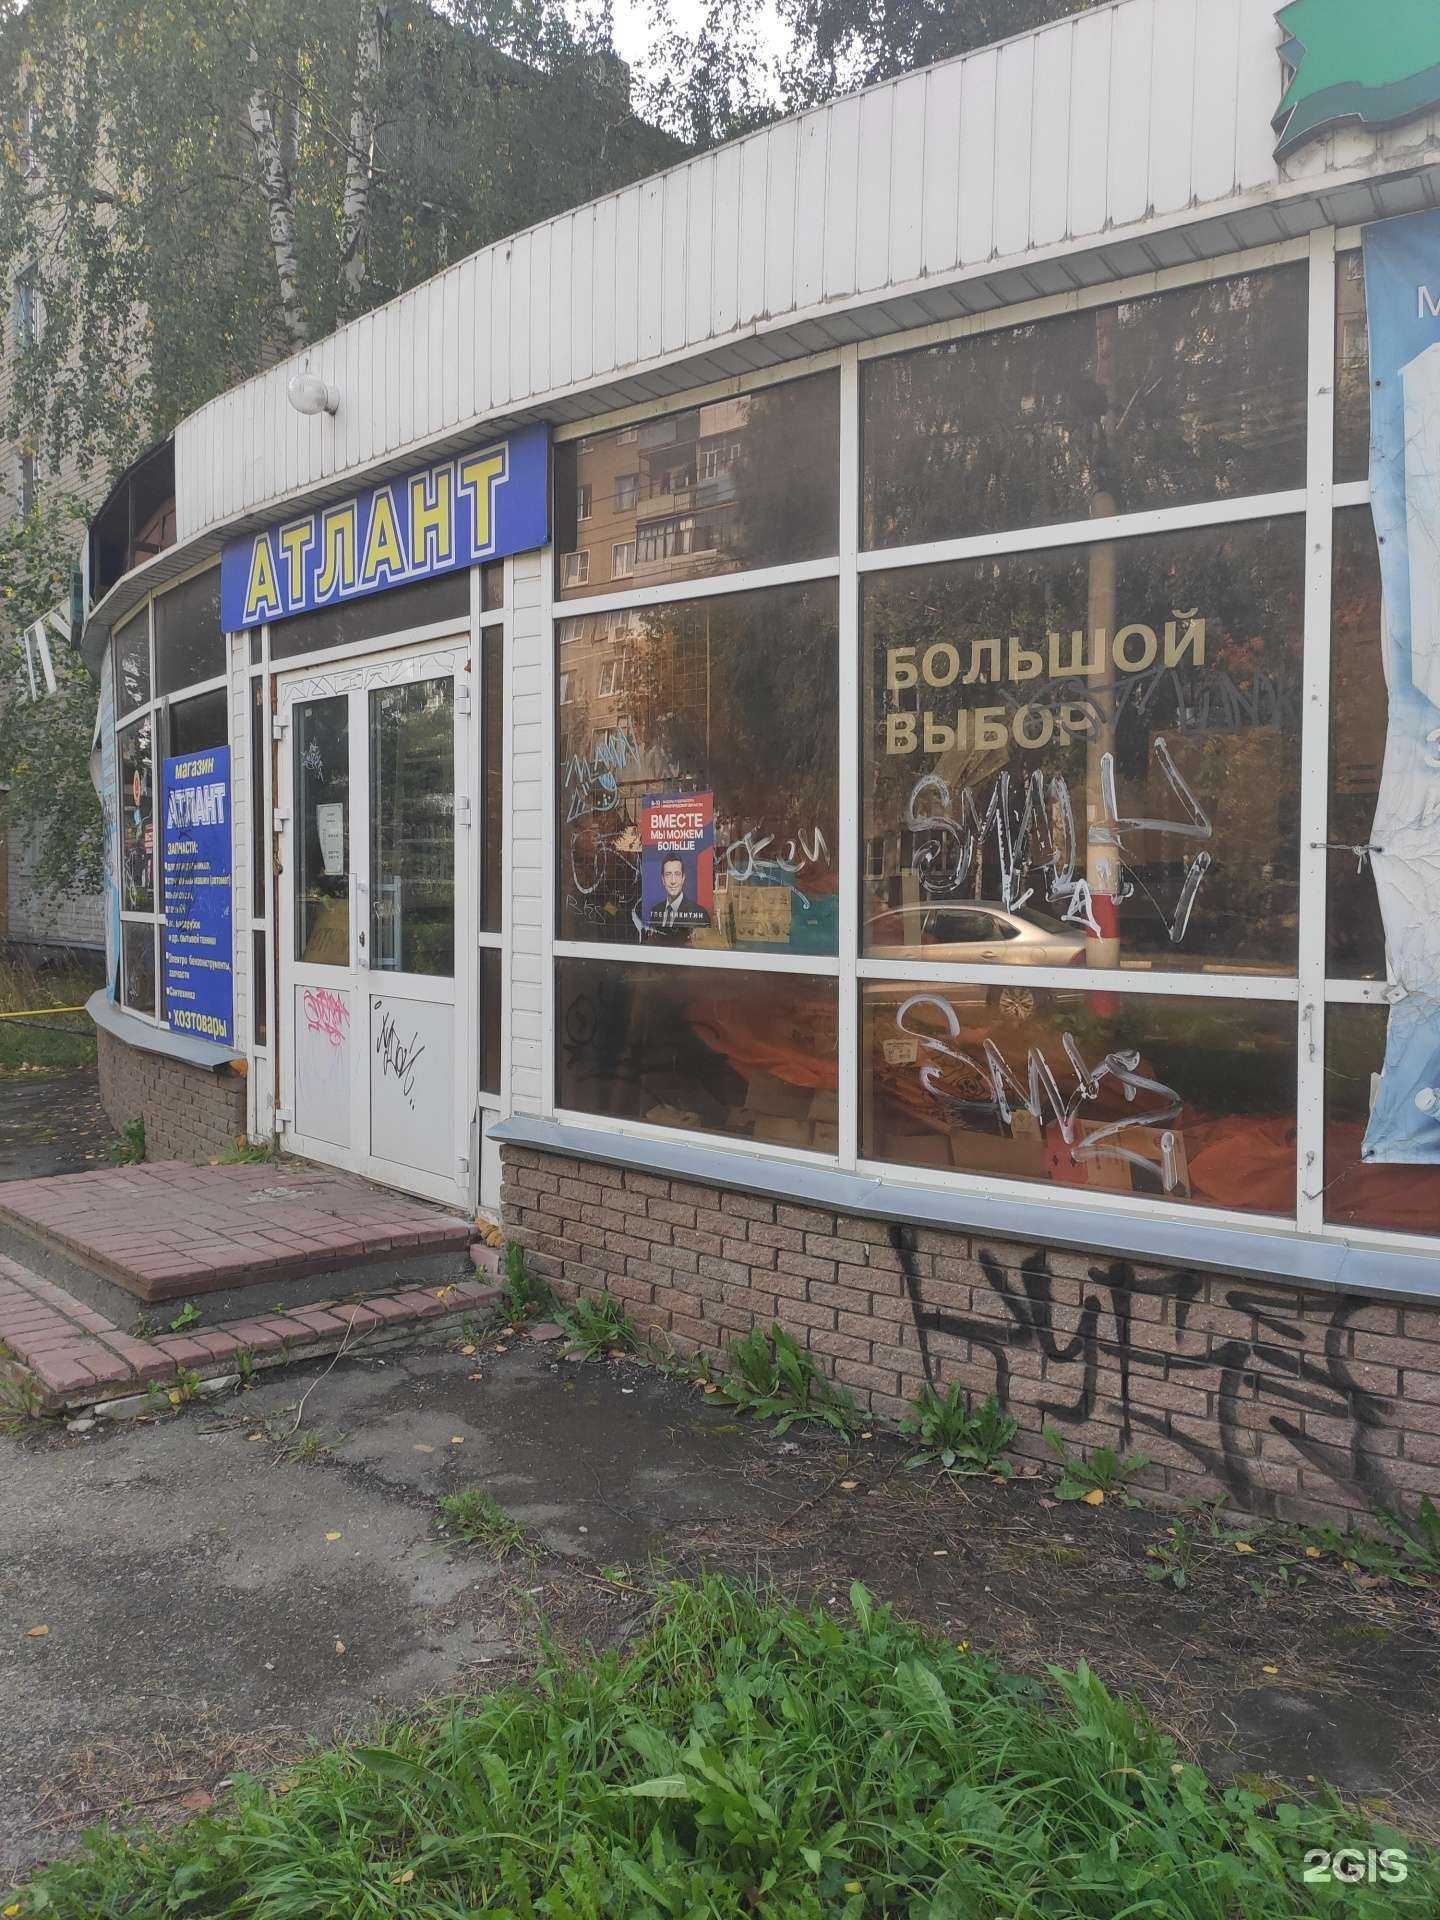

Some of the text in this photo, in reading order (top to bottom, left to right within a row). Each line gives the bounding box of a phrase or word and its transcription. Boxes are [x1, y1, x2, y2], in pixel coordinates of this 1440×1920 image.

[243, 440, 509, 625] АТЛАНТ
[887, 608, 1206, 690] БОЛЬШОЙ
[886, 701, 1100, 756] ВЫБОР
[175, 758, 214, 779] магазин
[167, 782, 226, 830] АТЛАНТ
[651, 813, 703, 829] ВМЕСТЕ
[651, 829, 703, 840] МЫ МОЖЕМ
[167, 841, 199, 855] ЗАПЧАСТИ:
[658, 841, 695, 851] БОЛЬШЕ
